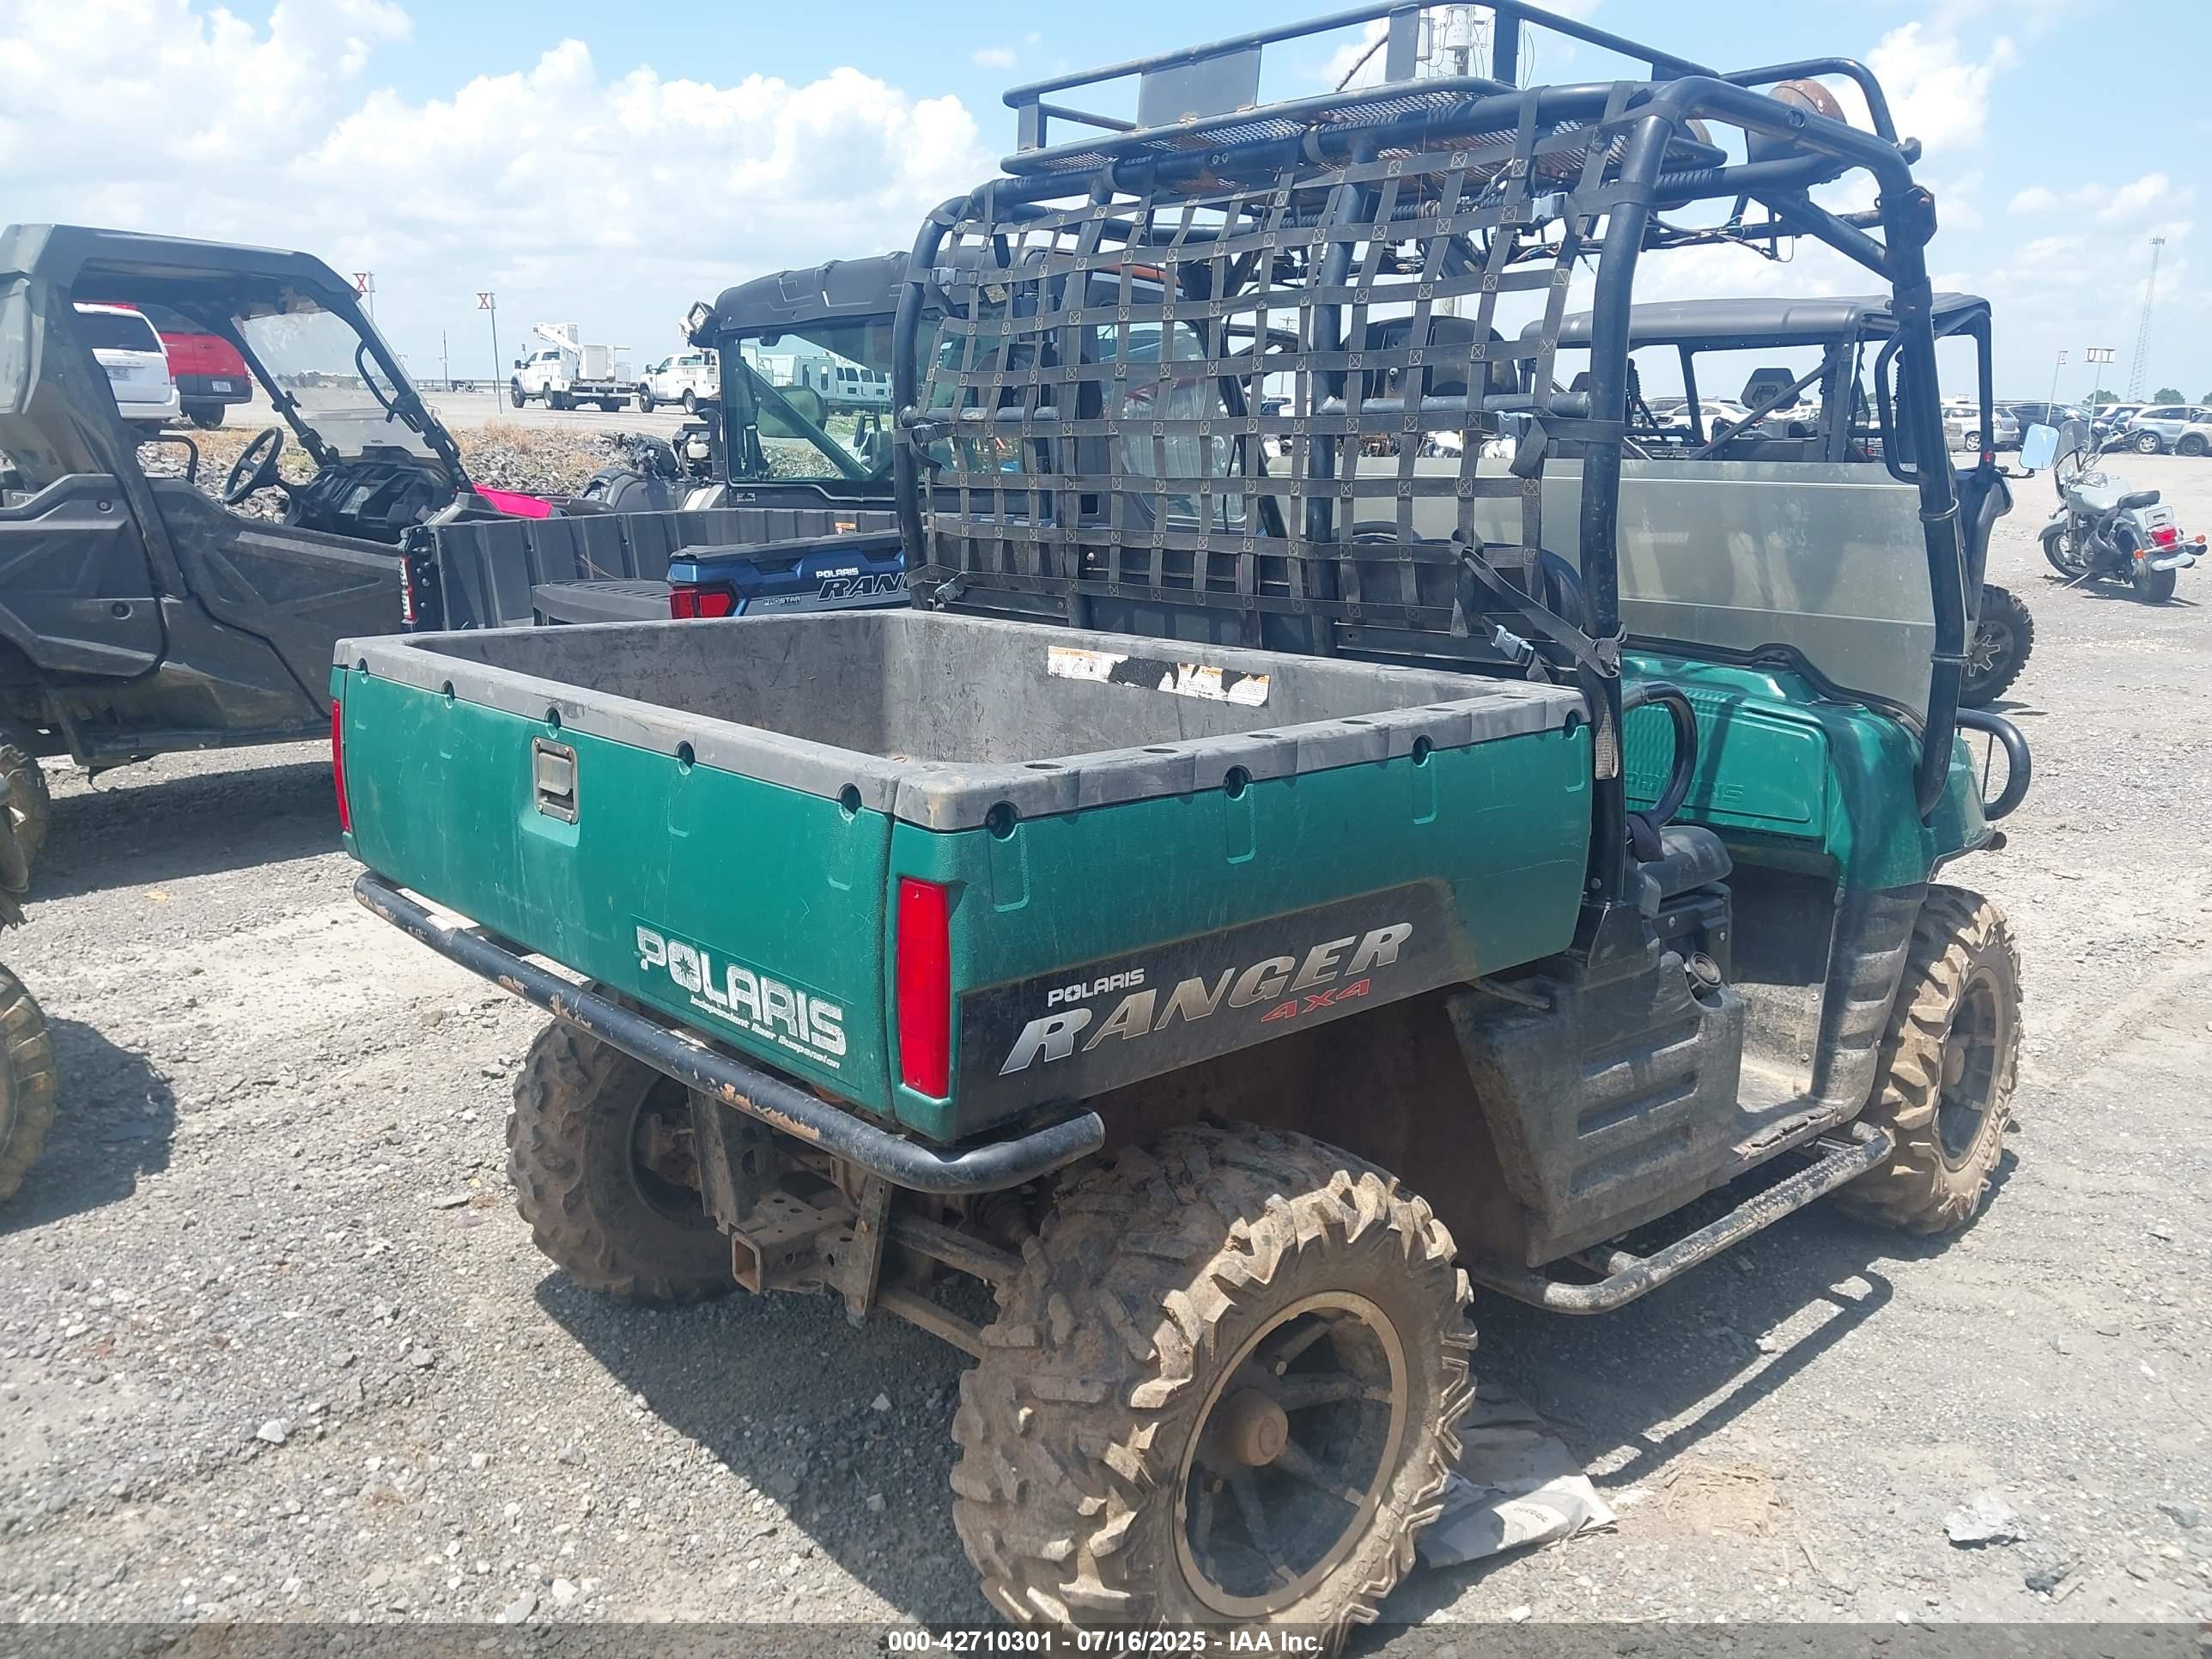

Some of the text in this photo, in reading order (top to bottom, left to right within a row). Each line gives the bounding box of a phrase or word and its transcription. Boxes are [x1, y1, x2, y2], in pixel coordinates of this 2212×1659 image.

[816, 567, 860, 579] POLARIS
[817, 572, 910, 602] RAN
[635, 926, 847, 1056] POLARIS
[998, 921, 1413, 1077] RANGER
[1047, 968, 1146, 1007] POLARIS
[1260, 978, 1371, 1024] 4X4
